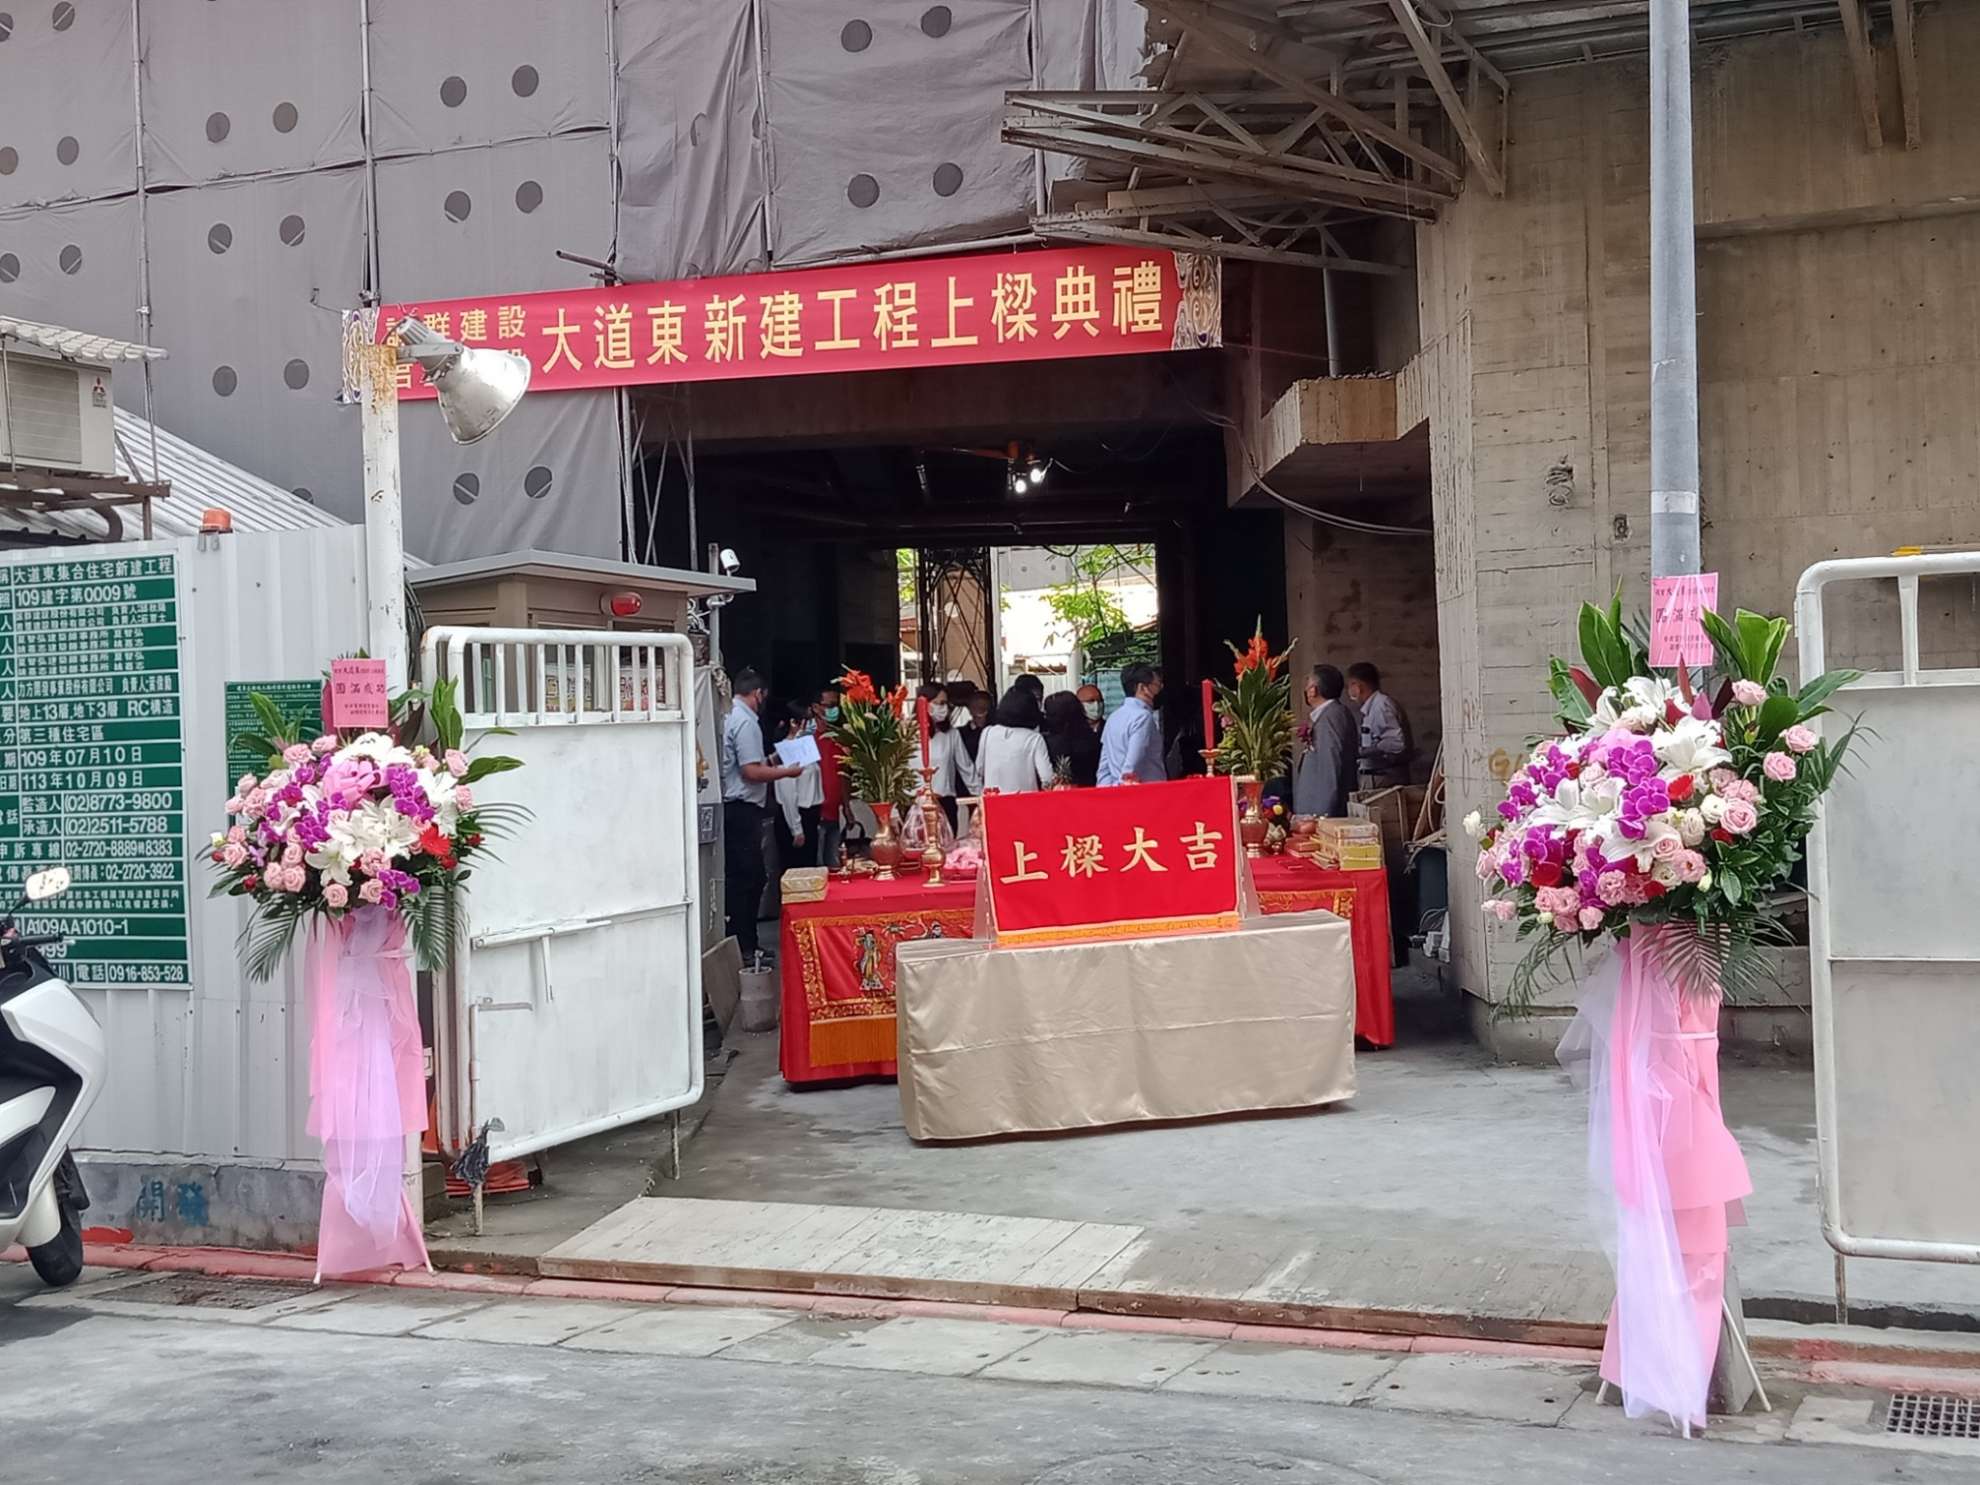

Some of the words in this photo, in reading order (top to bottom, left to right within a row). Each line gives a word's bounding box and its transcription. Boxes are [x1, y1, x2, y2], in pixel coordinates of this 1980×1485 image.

[385, 305, 526, 348] 群建設
[542, 261, 1162, 374] 大道東新建工程上樑典禮
[14, 558, 173, 584] 大道東集合住宅新建工程
[0, 728, 15, 744] 分
[19, 725, 104, 744] 第三種住宅區
[21, 747, 142, 767] 109年07月10日
[23, 771, 143, 790] 113年10月09日
[23, 795, 61, 813] 監造人
[64, 793, 172, 812] (02)8773-9800
[23, 819, 61, 835] 承造人
[65, 816, 168, 835] (02)2511-5788
[1000, 821, 1223, 885] 上樑大吉
[27, 919, 129, 935] A109AA1010-1
[78, 964, 105, 981] 電話
[110, 965, 183, 982] 0916-853-528
